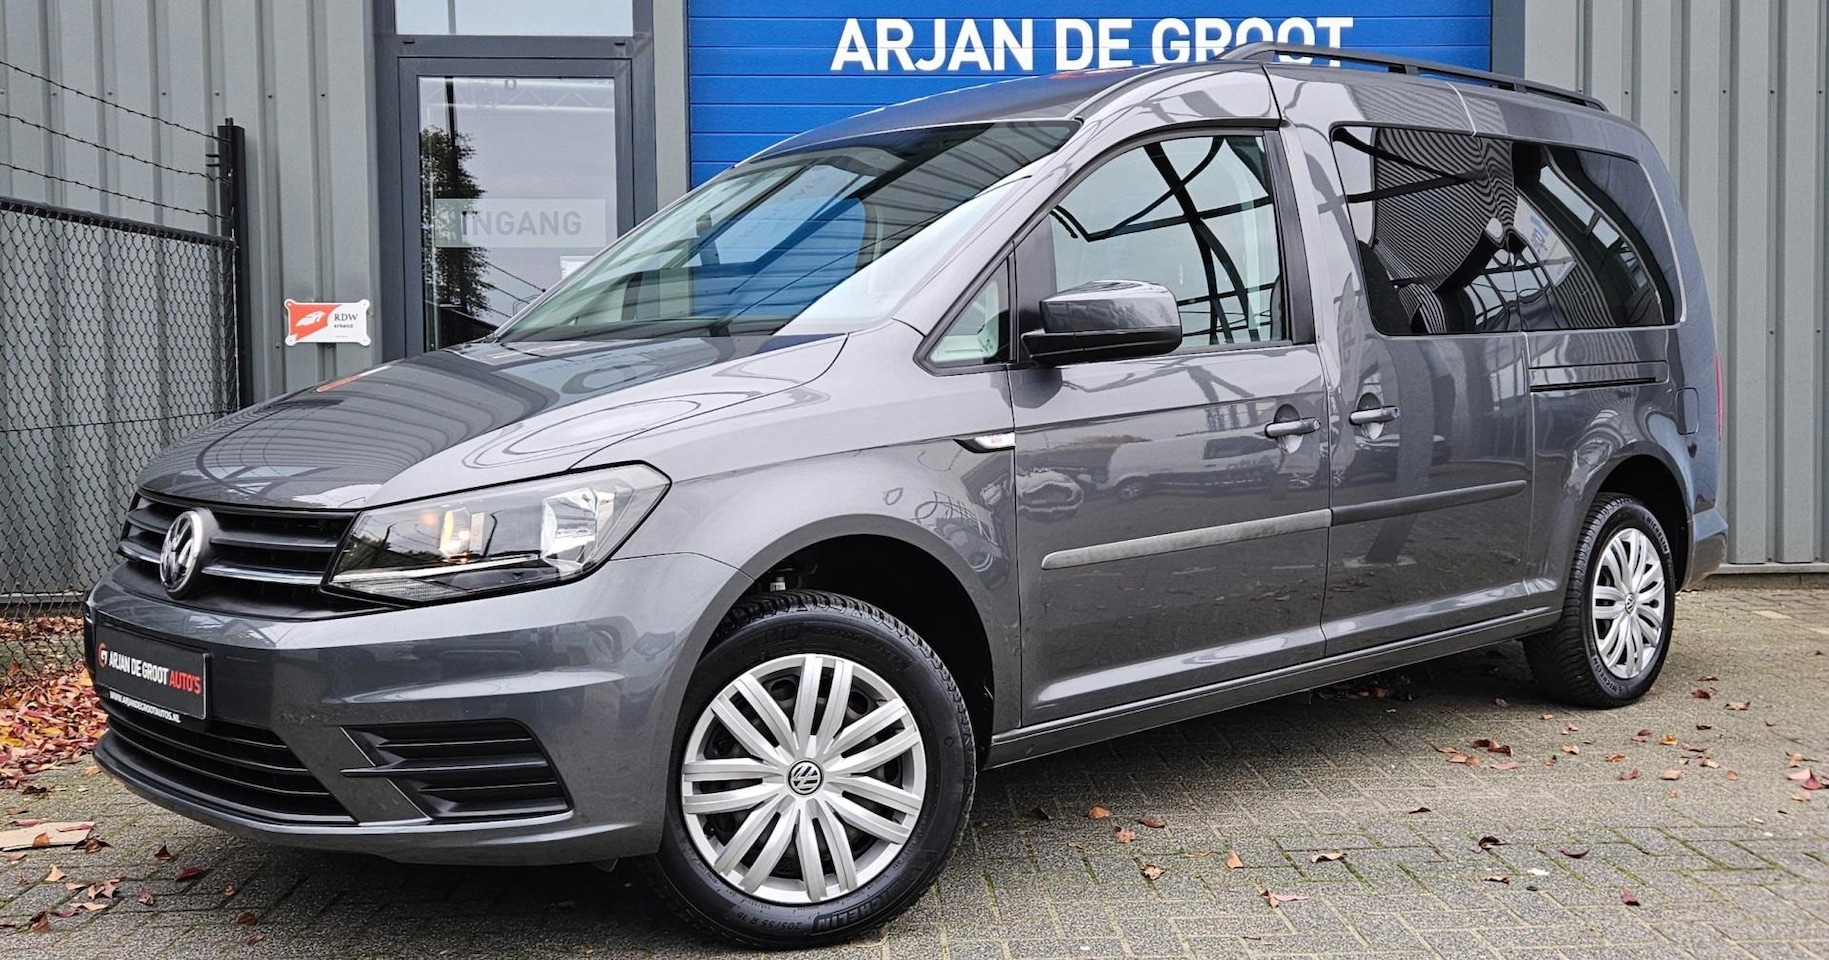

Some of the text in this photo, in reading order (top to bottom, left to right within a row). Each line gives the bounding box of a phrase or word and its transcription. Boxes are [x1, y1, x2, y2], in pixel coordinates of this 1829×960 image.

[831, 18, 1033, 71] ARJAN
[1055, 18, 1132, 69] DE
[462, 210, 582, 236] INGANG
[334, 313, 358, 321] RDW
[108, 650, 130, 673] ARJAN
[130, 658, 142, 677] DE
[142, 662, 169, 686] GROOT
[169, 670, 202, 695] AUTO'S
